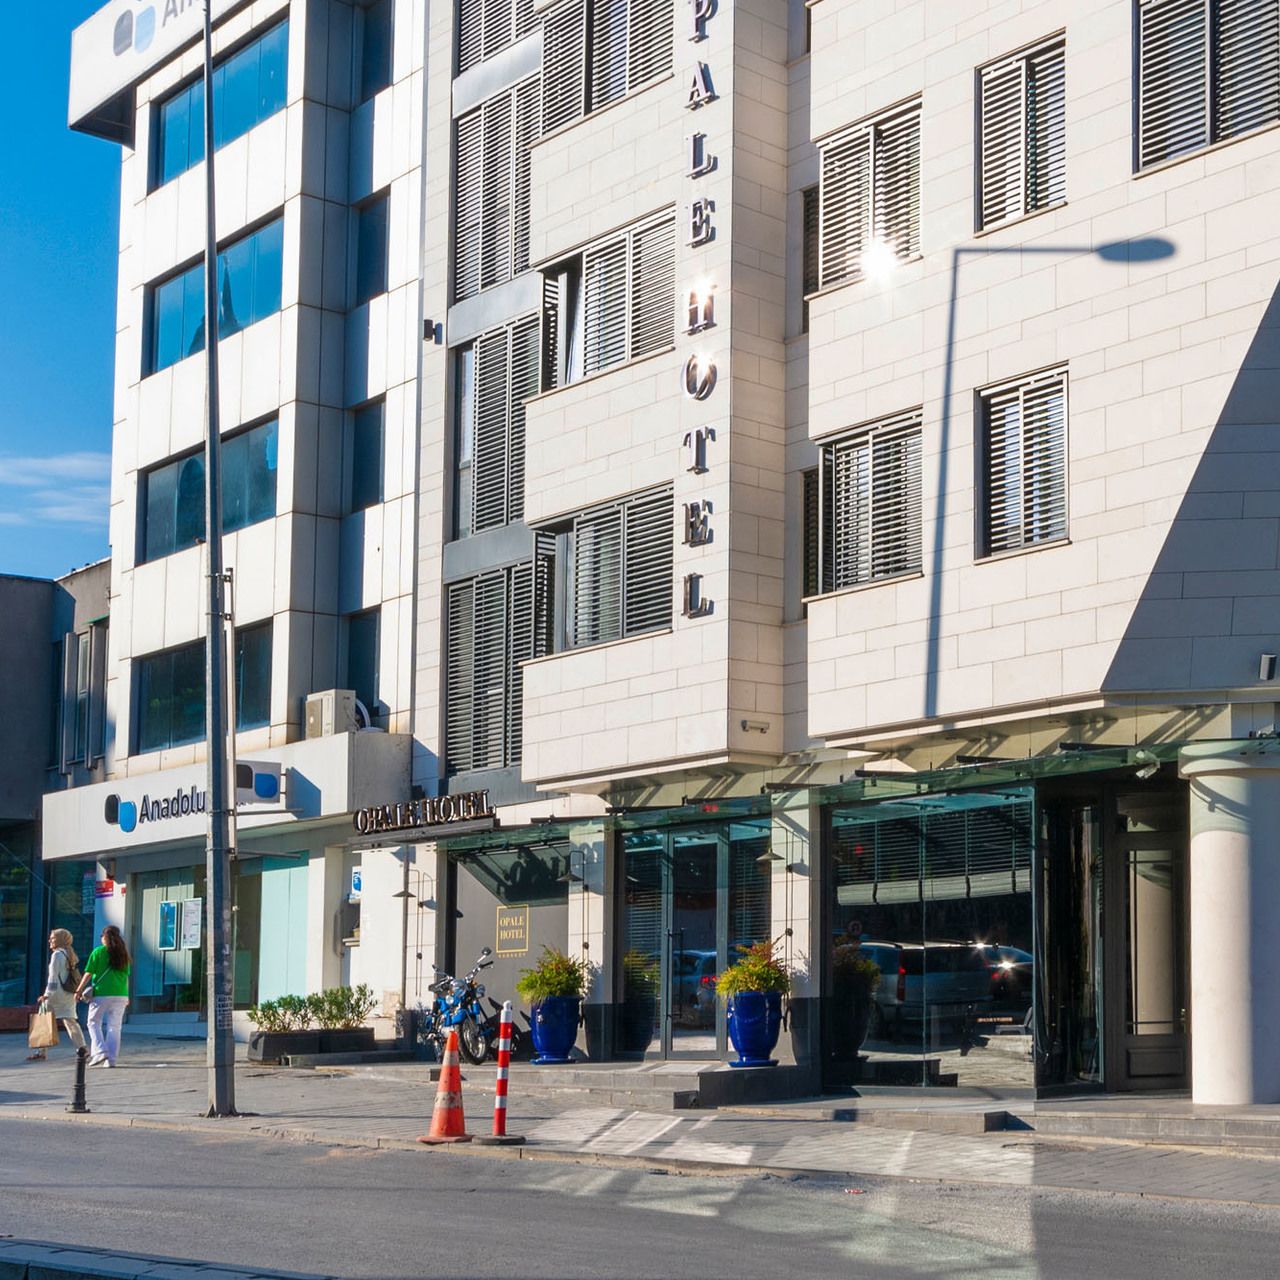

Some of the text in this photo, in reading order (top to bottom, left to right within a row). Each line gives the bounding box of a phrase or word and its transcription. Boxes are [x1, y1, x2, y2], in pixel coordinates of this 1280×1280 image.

[680, 281, 719, 620] HOTEL
[138, 785, 207, 824] Anadolu
[352, 788, 497, 836] OPALE HOTEL
[499, 915, 524, 927] OPALE
[500, 928, 526, 940] HOTEL
